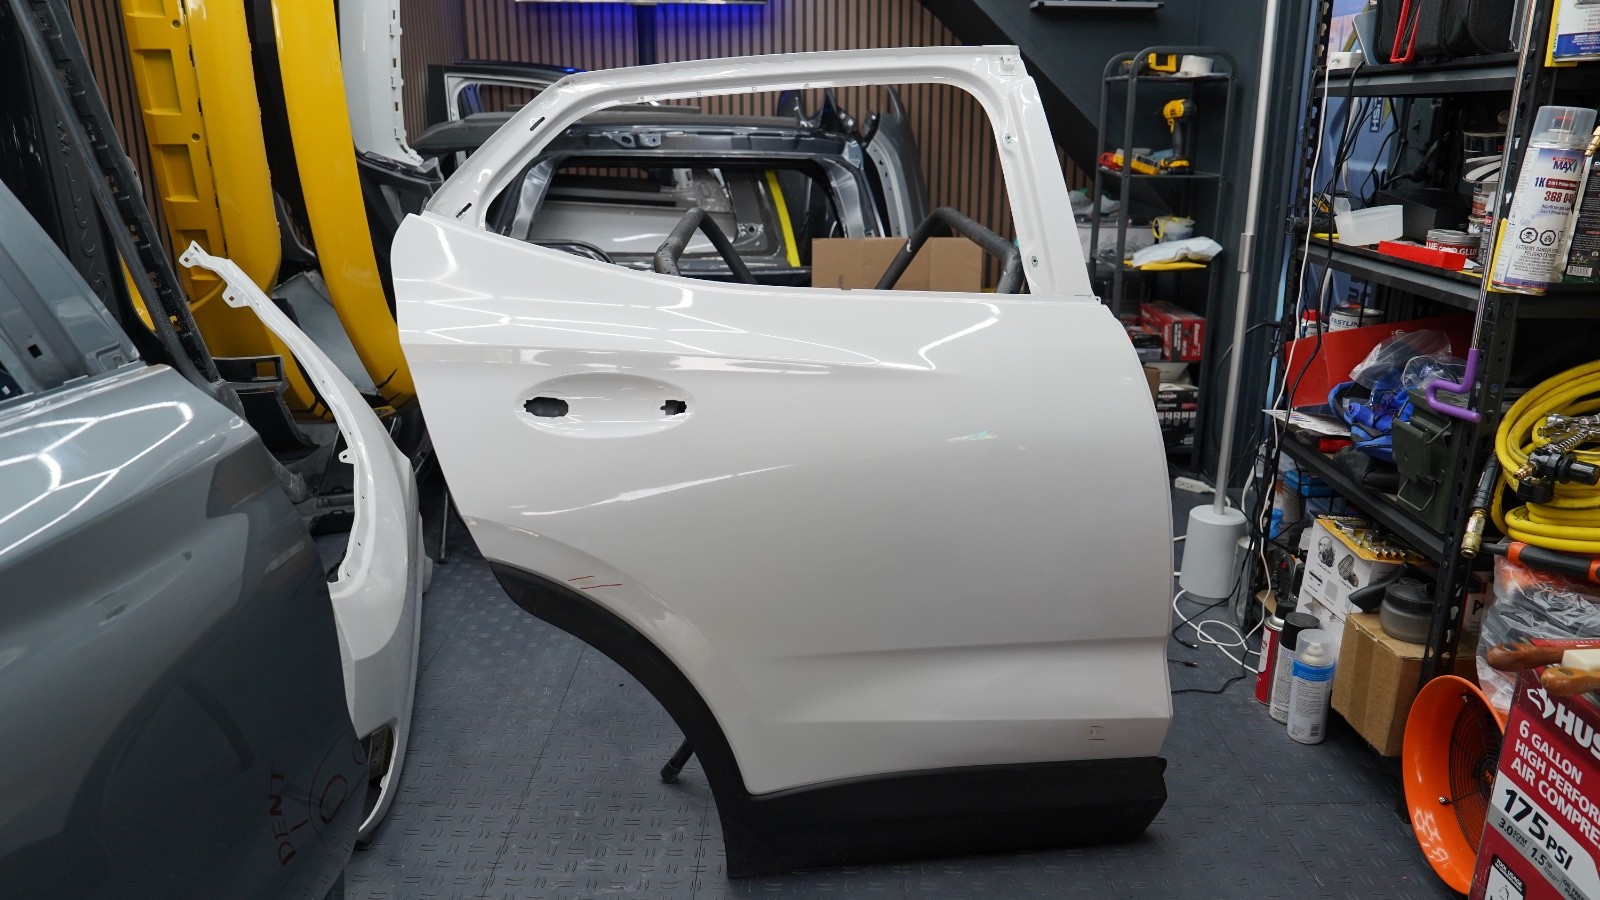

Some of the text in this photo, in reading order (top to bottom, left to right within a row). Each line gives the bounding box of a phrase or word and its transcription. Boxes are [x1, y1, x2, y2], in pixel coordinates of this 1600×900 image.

[1535, 177, 1546, 187] 1K
[1553, 160, 1576, 173] MAX
[1544, 191, 1562, 202] 368
[1460, 247, 1478, 256] GLUE
[1331, 317, 1362, 328] FASTLIN
[1519, 719, 1583, 785] 6 GALLON
[1510, 757, 1600, 850] AIR COMPRE
[1514, 739, 1600, 826] HIGH PERFOR
[269, 761, 297, 866] DENT
[1504, 788, 1549, 841] 175
[1545, 834, 1573, 871] PSI
[1498, 818, 1514, 836] 3.0
[1530, 847, 1547, 866] 1.5
